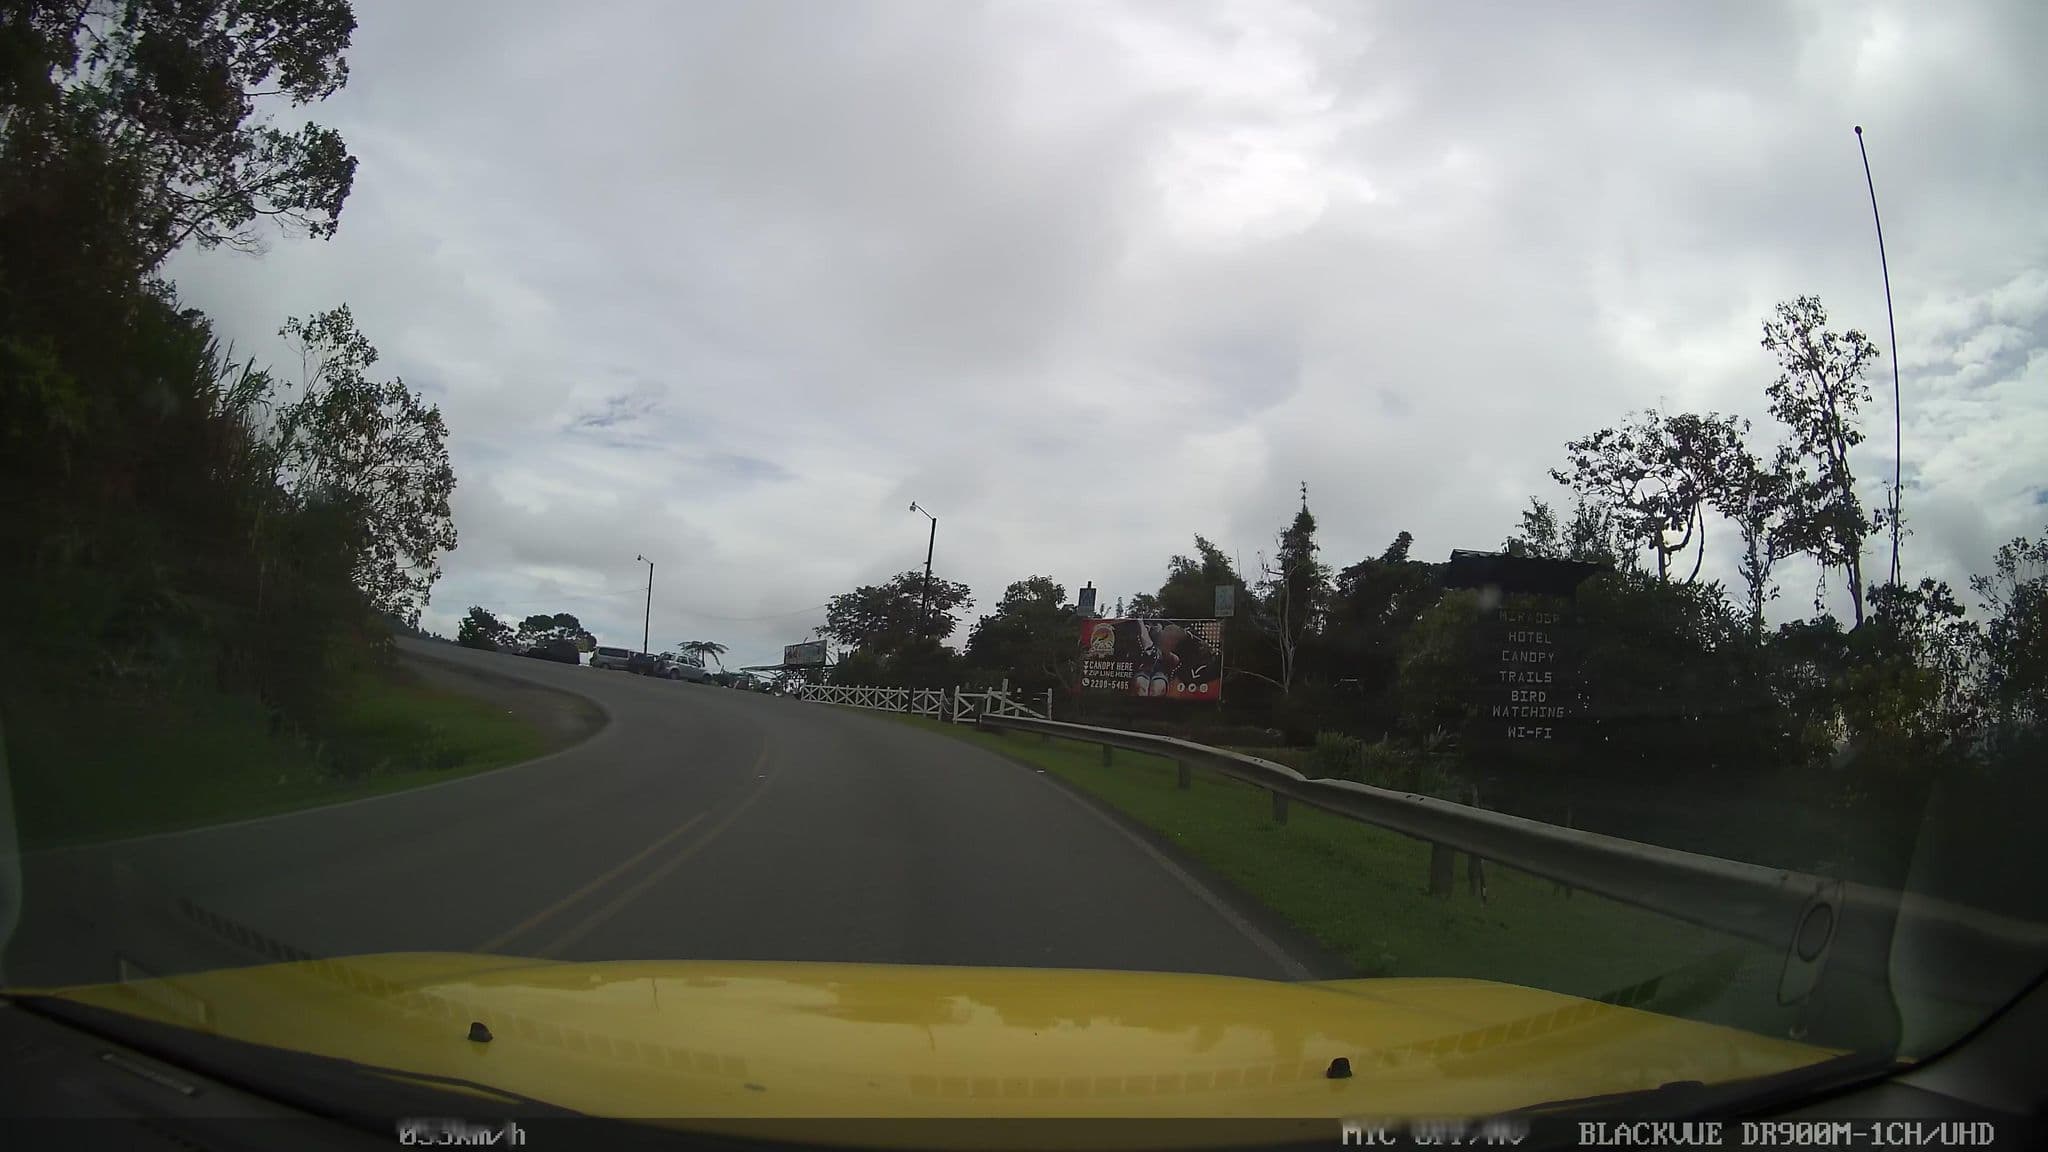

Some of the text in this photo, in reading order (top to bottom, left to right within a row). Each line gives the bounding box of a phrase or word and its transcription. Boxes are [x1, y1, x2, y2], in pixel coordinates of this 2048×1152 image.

[1508, 631, 1552, 644] HOTEL
[1502, 649, 1554, 662] CANOPY
[1089, 660, 1133, 671] CANOPY HERE
[1499, 670, 1552, 683] TRAILS
[1511, 690, 1546, 703] BIRD
[1493, 705, 1564, 718] WATCHING
[1507, 726, 1552, 739] WI-FI
